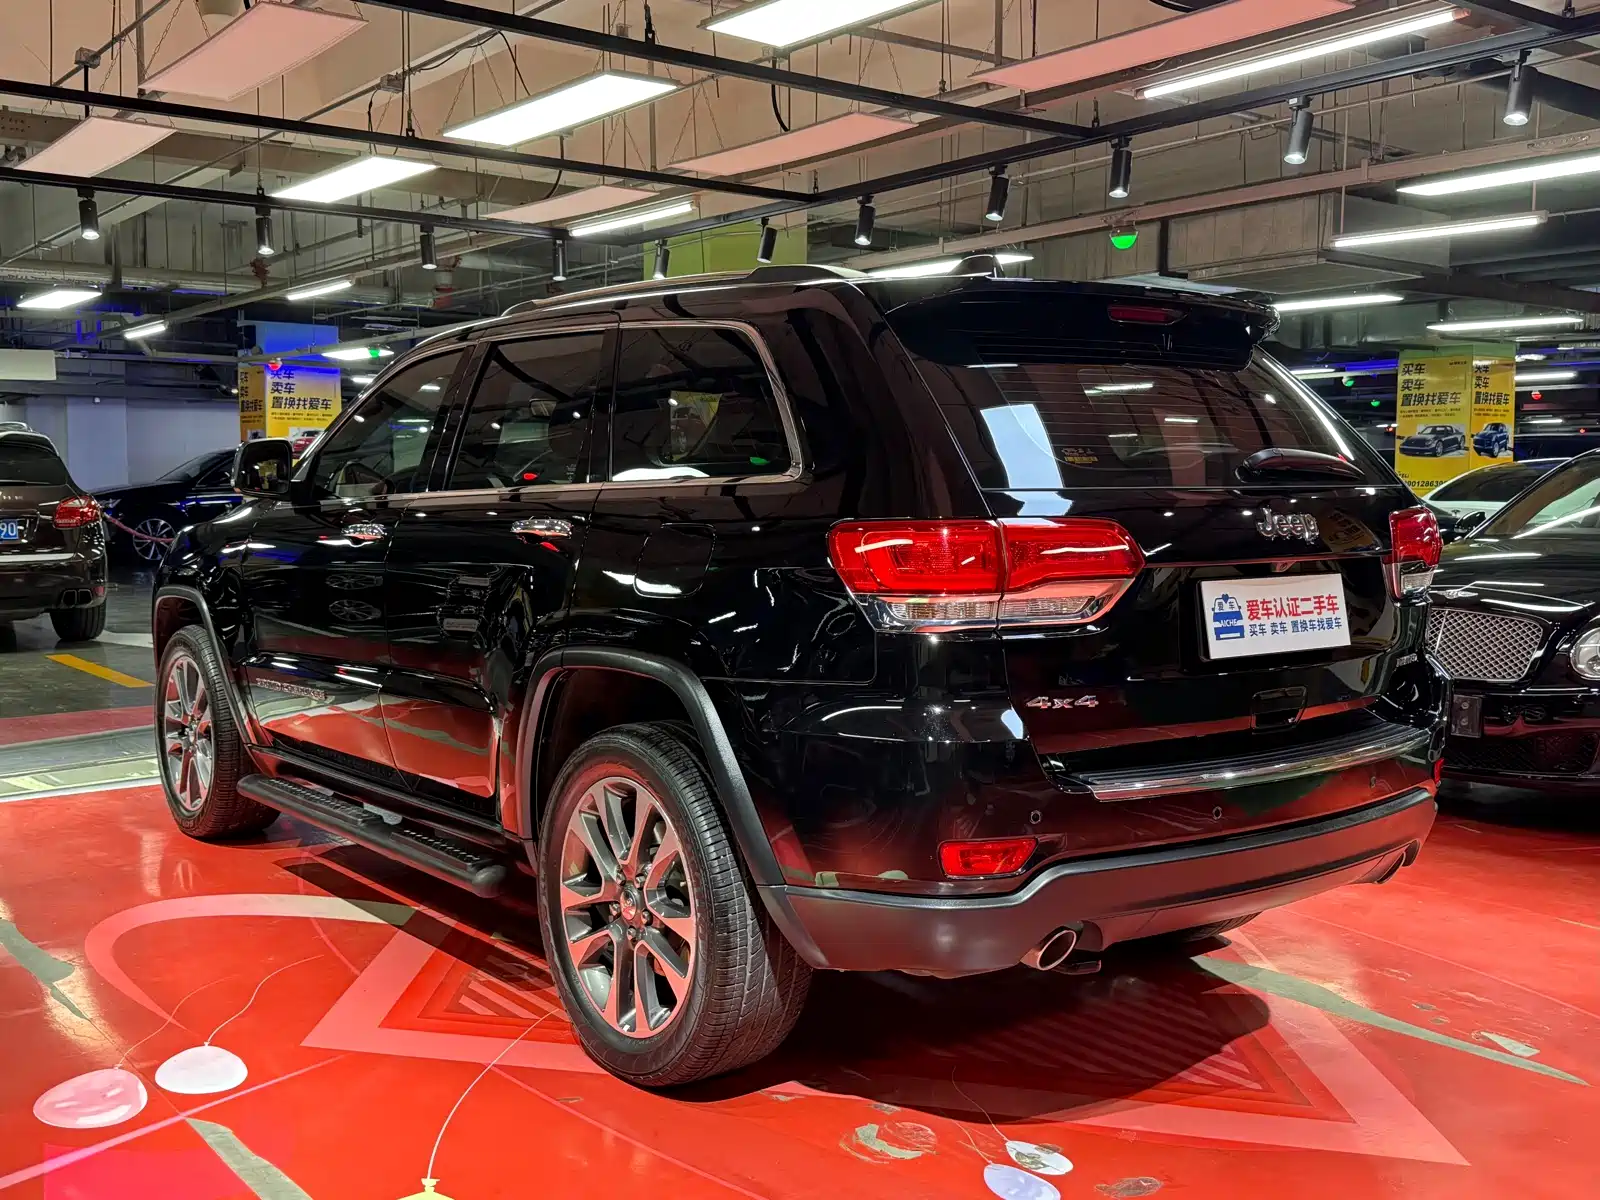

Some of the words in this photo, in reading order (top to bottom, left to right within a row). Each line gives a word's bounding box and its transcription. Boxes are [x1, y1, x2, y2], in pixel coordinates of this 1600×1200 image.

[1402, 363, 1426, 376] 买车
[271, 382, 296, 394] 卖车
[271, 396, 333, 410] 置换找爱车
[1401, 392, 1461, 406] 置换找爱车
[1257, 507, 1319, 541] Jeep
[1246, 594, 1340, 621] 爱车认证二手车
[1249, 623, 1267, 637] 买车
[1270, 621, 1288, 635] 卖车
[1291, 617, 1342, 633] 置换车找爱车
[1026, 695, 1099, 709] 4x4
